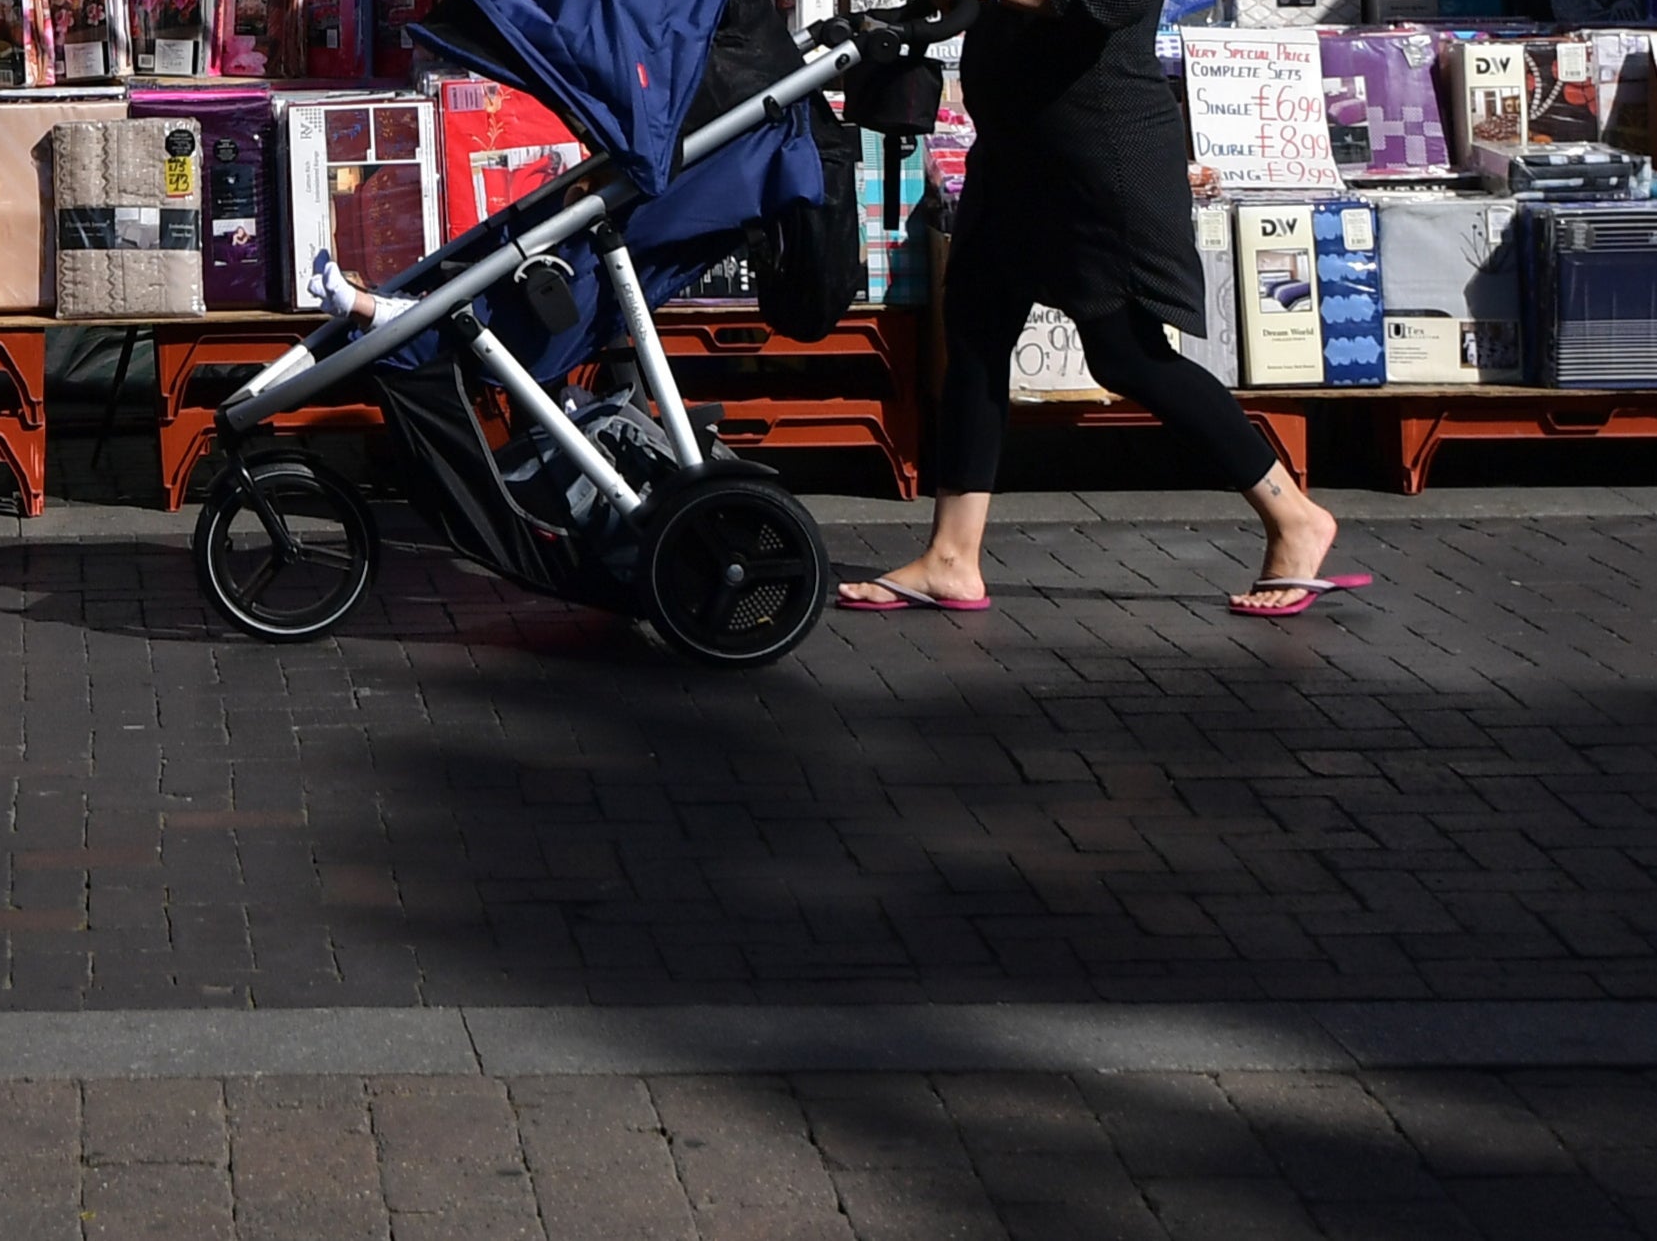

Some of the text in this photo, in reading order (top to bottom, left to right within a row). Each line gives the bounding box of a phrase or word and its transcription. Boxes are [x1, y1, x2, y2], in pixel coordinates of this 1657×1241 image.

[1187, 42, 1311, 63] VERY SPECIAL PRICE
[1191, 61, 1302, 81] COMPLETE SETS
[1475, 57, 1512, 76] DW
[1197, 84, 1322, 123] SINGLE £6.99
[1197, 132, 1255, 157] DOUBLE
[1220, 161, 1338, 184] ING £9.99
[1260, 218, 1299, 238] DW
[1262, 327, 1315, 337] Dream World
